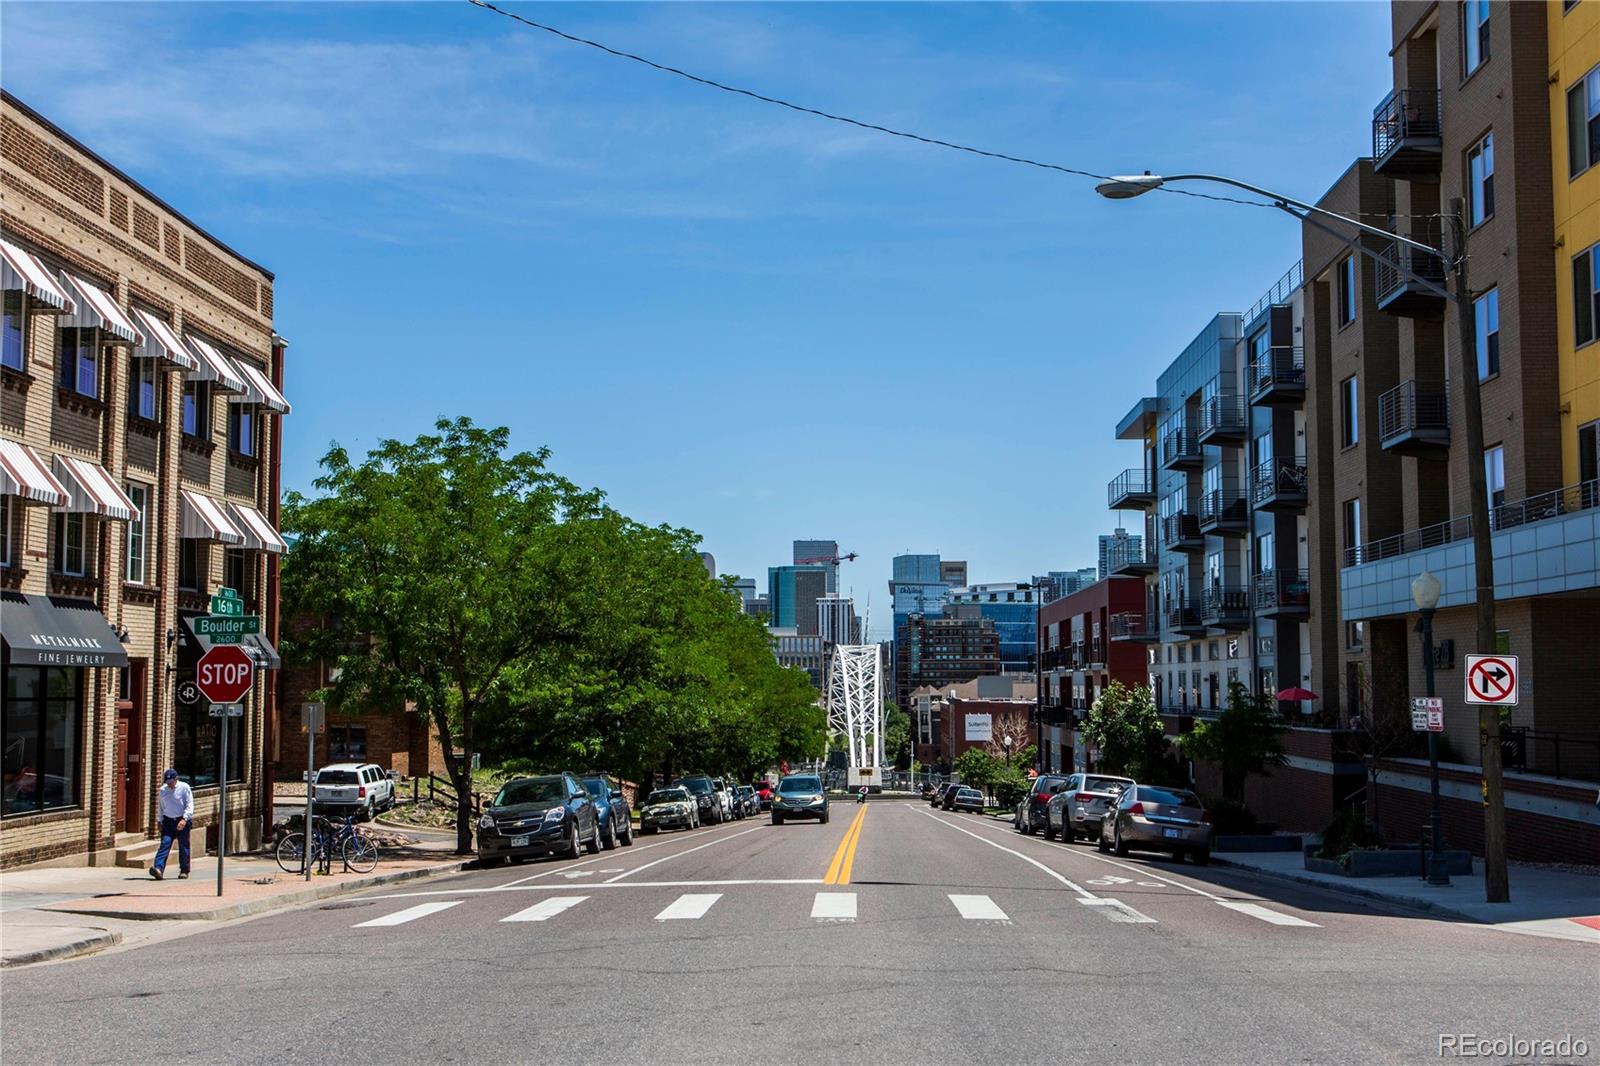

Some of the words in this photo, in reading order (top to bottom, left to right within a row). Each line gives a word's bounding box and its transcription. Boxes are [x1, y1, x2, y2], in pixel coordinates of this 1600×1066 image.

[217, 599, 233, 614] 16th
[200, 619, 245, 633] Boulder
[248, 620, 257, 629] St
[30, 633, 102, 649] METALMARK
[216, 635, 236, 643] 2600
[38, 652, 61, 663] FINE
[65, 654, 105, 665] JEWELRY
[201, 663, 249, 685] STOP
